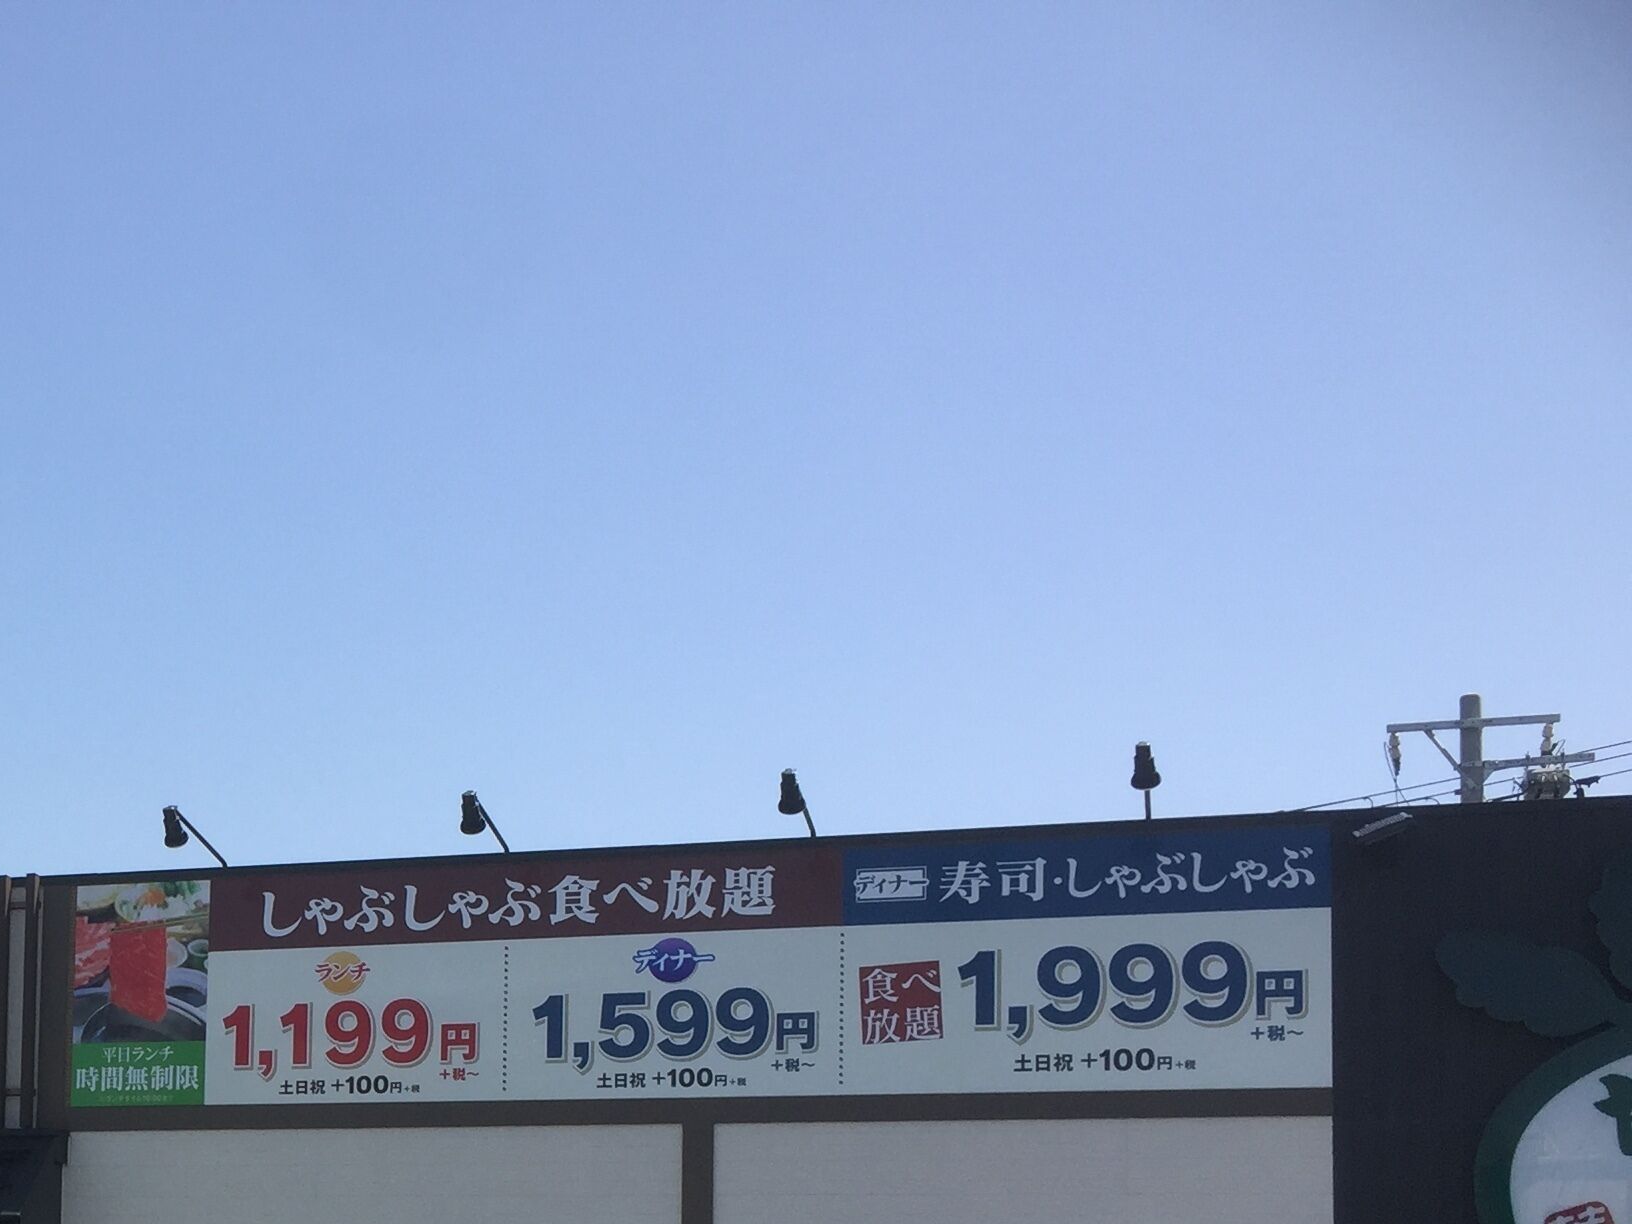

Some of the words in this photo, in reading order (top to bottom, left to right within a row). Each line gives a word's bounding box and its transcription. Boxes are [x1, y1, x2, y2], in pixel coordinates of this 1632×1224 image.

[853, 872, 930, 898] ディナー
[262, 865, 776, 937] しゃぶしゃぶ食べ放題
[314, 962, 371, 982] ランチ
[633, 948, 716, 974] ディナー
[862, 968, 942, 1005] 食べ
[957, 940, 1310, 1041] 1,999円
[531, 987, 819, 1075] 1,599円
[863, 1005, 942, 1044] 放題
[222, 998, 480, 1080] 1,199円
[103, 1045, 174, 1063] 平日ランチ
[1013, 1053, 1073, 1072] 土日祝
[75, 1065, 199, 1092] 時間無制限
[279, 1080, 325, 1095] 土日祝
[596, 1073, 646, 1089] 土日祝
